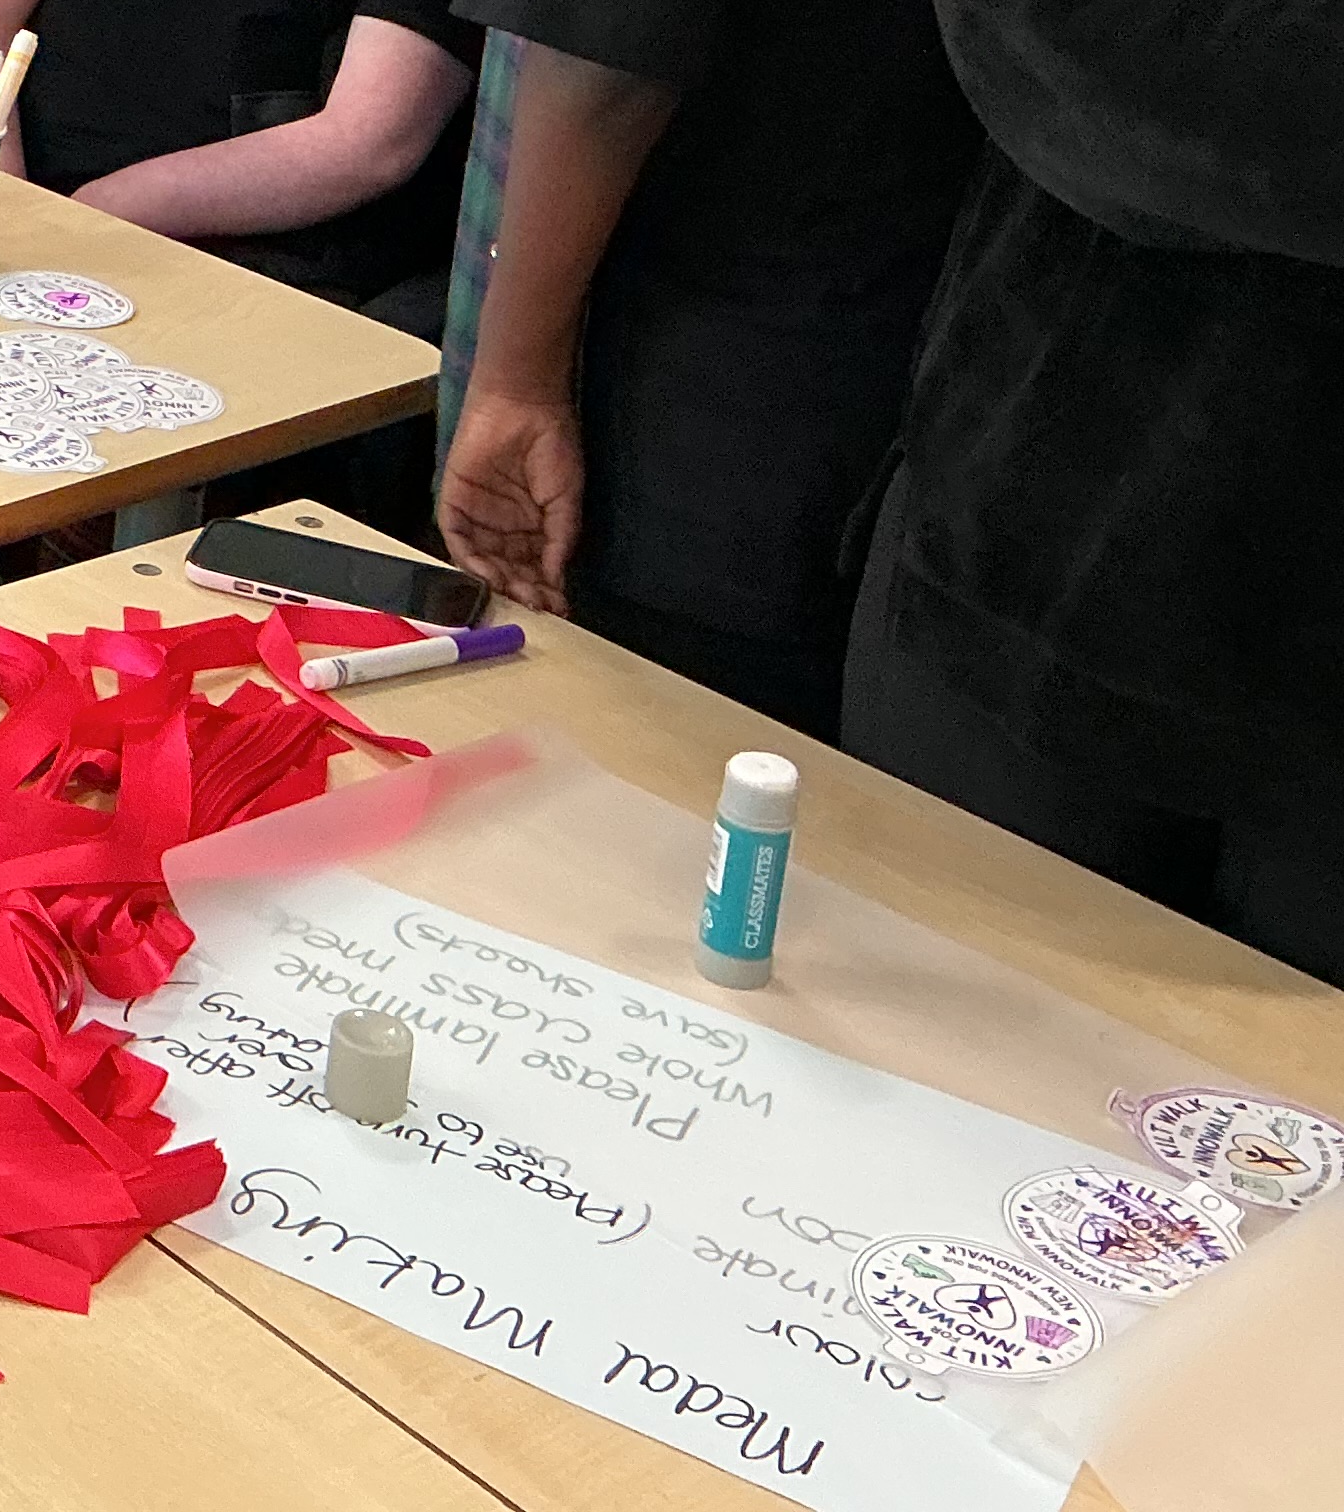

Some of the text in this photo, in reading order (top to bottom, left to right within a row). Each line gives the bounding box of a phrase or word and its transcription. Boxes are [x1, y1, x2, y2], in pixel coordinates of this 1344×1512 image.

[9, 387, 39, 401] KILT
[65, 413, 113, 423] WALK
[160, 409, 199, 420] KILT
[25, 455, 71, 468] WALK
[745, 846, 774, 949] CLASSMATES
[265, 1077, 334, 1115] off
[520, 1048, 701, 1142] Please
[436, 1112, 484, 1146] to
[1149, 1097, 1211, 1160] KILT WALK
[1191, 1105, 1237, 1171] INNOWALK
[494, 1137, 572, 1178] use
[940, 1255, 967, 1269] OUR
[943, 1244, 1042, 1287] INNOWALK
[967, 1263, 990, 1276] FOR
[1034, 1243, 1122, 1292] INNOWALK
[1043, 1284, 1078, 1312] NEW
[227, 1167, 825, 1477] Medal Making
[869, 1295, 1014, 1371] KILT WALK
[883, 1284, 1026, 1358] INNOWALK
[928, 1325, 962, 1344] FOR
